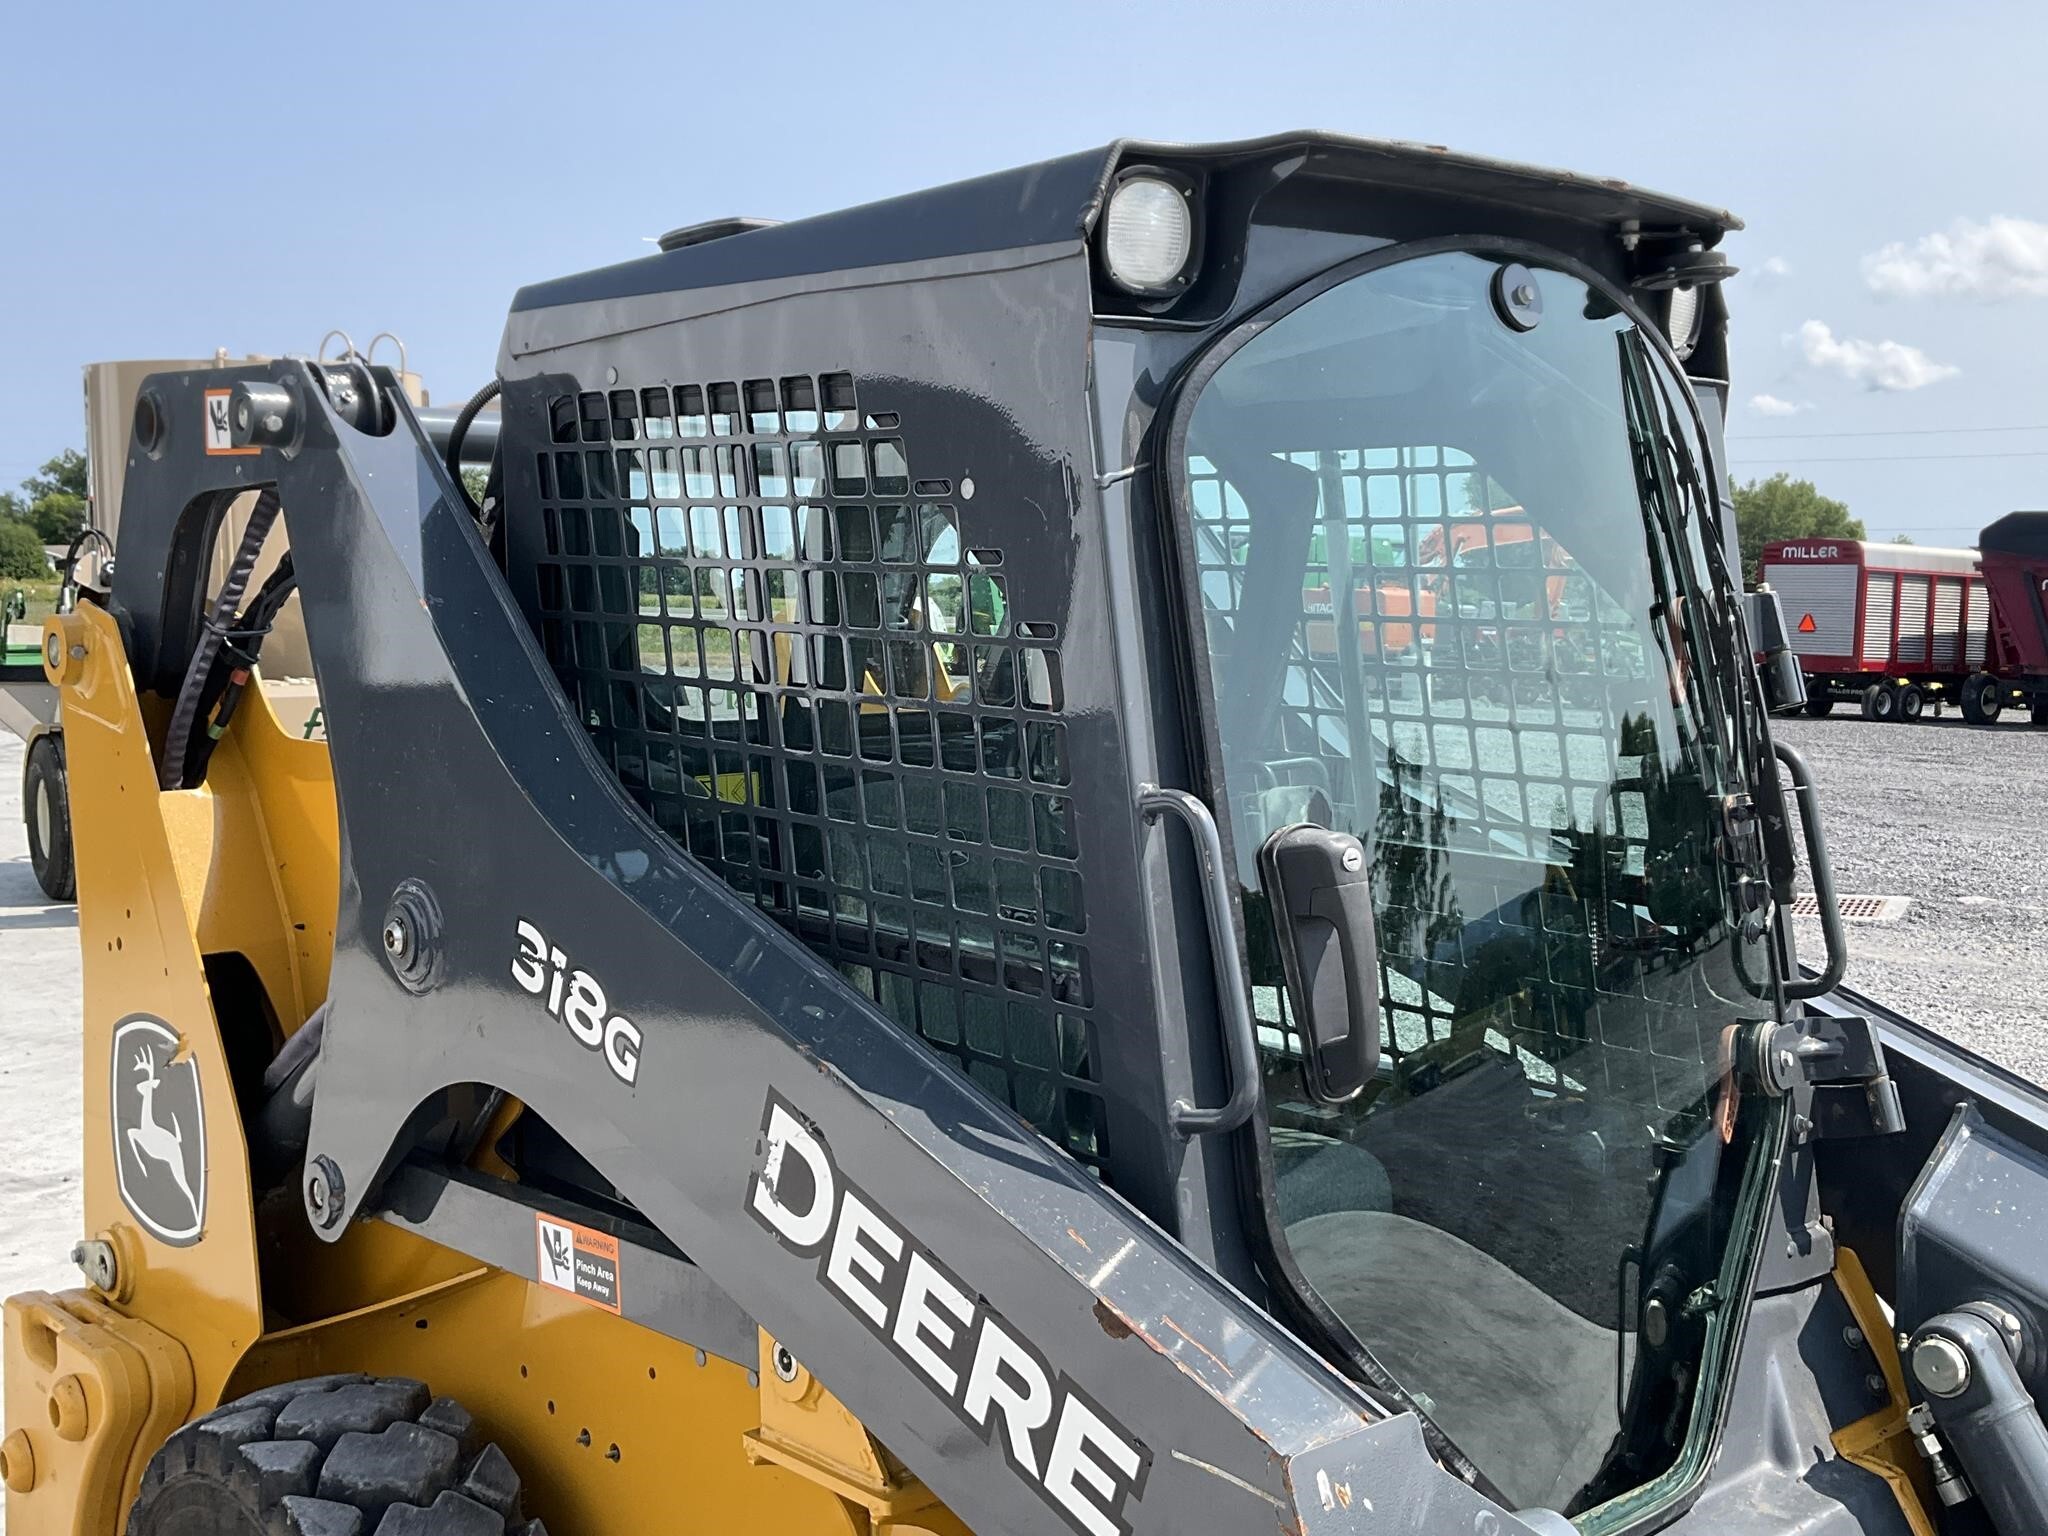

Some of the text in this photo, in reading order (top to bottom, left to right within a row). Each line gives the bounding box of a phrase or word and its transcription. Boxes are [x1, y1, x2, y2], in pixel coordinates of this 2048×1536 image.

[1783, 546, 1838, 558] MILLER
[511, 919, 642, 1083] 318G
[581, 1236, 615, 1254] WARNING
[575, 1258, 614, 1282] Pinch Area
[576, 1275, 610, 1296] Keep Away
[753, 1102, 1142, 1536] DEERE
